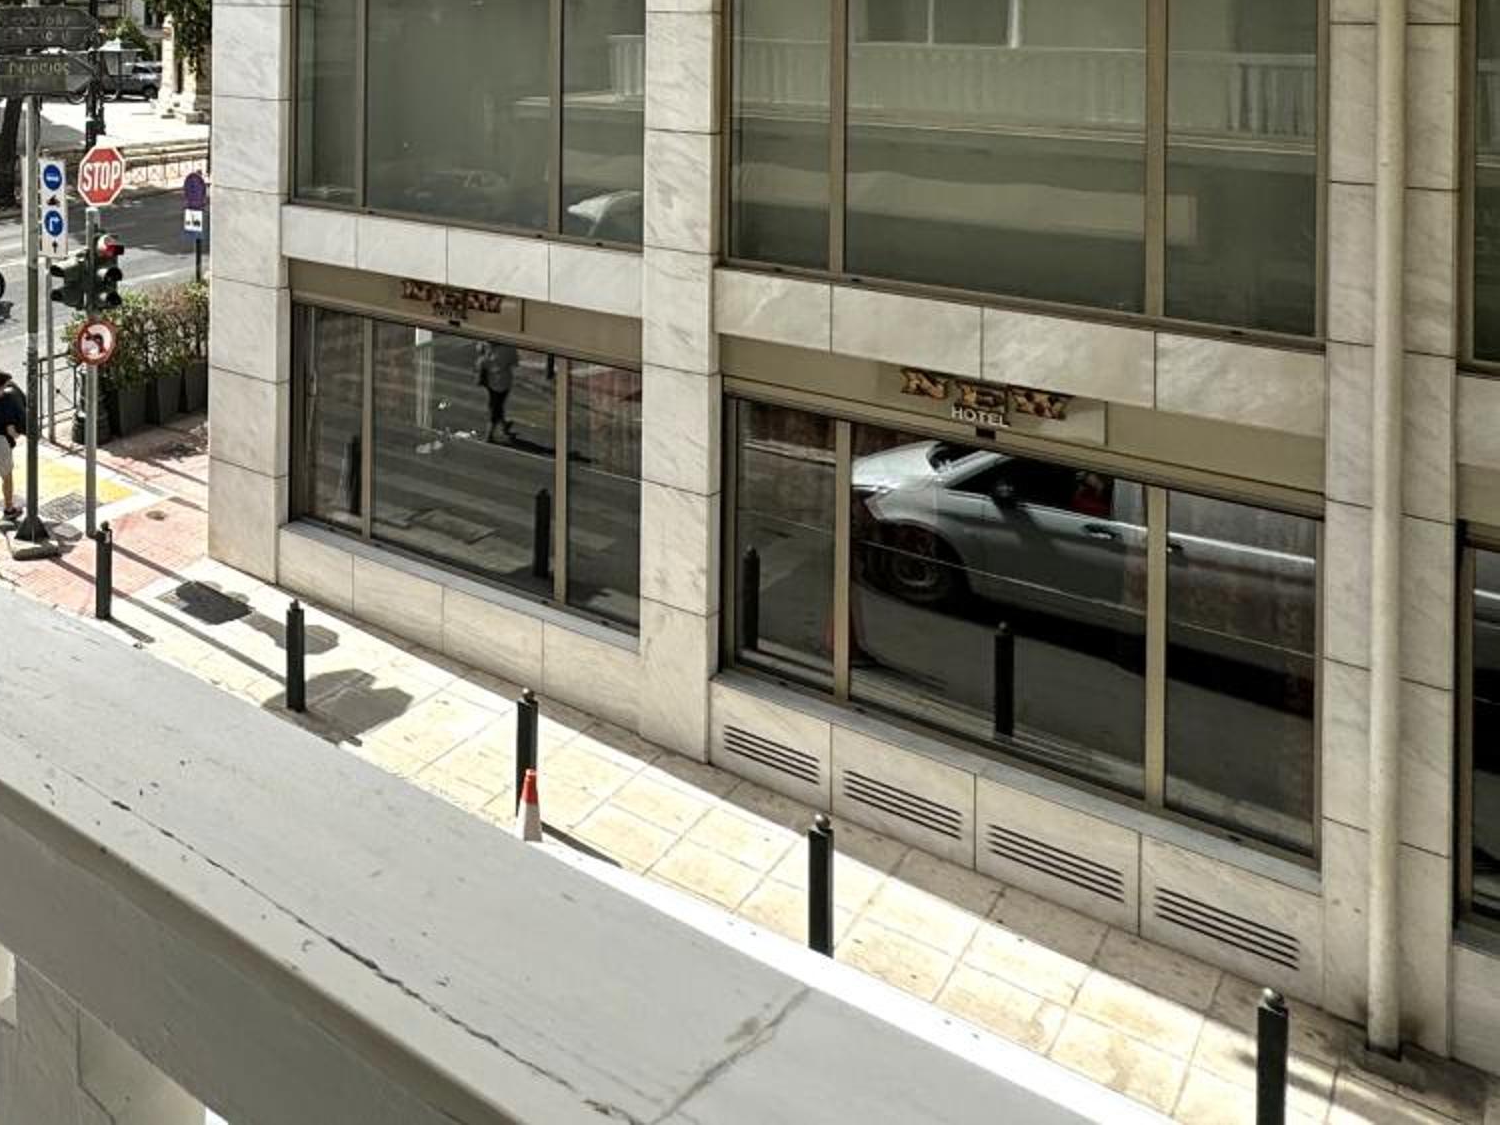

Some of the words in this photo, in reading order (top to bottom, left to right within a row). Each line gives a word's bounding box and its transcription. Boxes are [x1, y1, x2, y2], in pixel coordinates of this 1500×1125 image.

[82, 160, 121, 192] STOP
[900, 366, 1074, 421] NEW
[951, 405, 1010, 428] HOTEL
